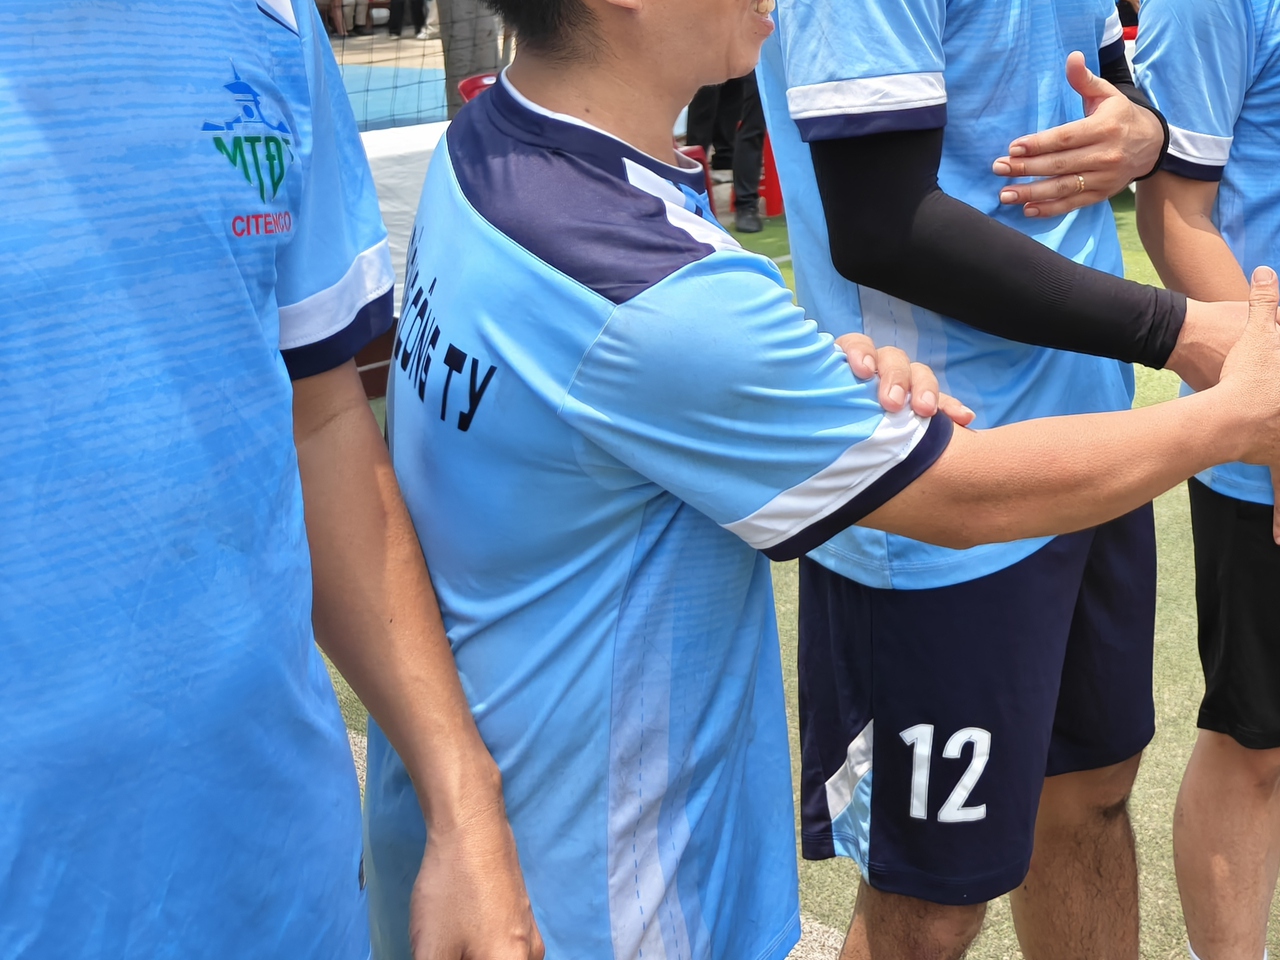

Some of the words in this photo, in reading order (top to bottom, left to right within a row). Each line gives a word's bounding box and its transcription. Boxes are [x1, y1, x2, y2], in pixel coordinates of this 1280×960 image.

[232, 211, 292, 237] CITENCO
[440, 343, 498, 432] TY
[899, 723, 992, 823] 12
